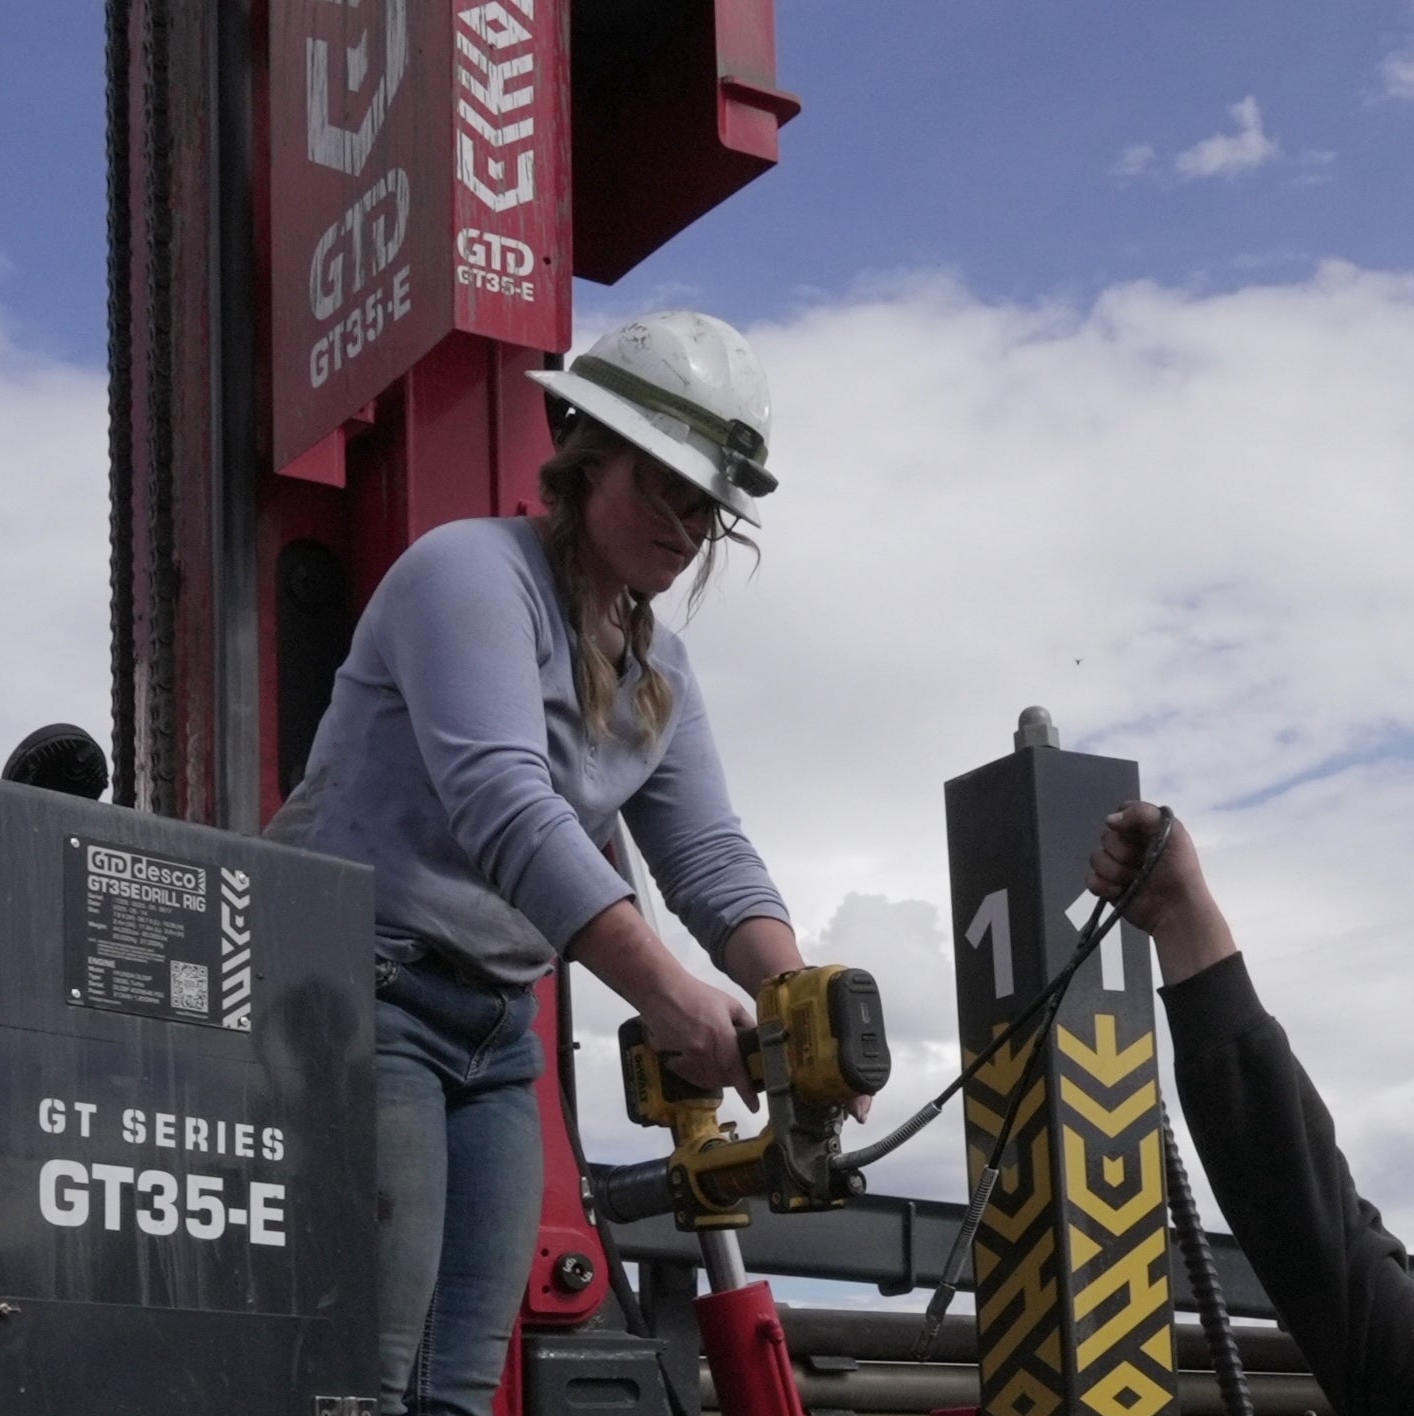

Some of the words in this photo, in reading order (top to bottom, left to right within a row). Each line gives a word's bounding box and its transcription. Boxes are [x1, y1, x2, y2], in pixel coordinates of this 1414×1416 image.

[309, 168, 410, 321] GTD
[456, 227, 535, 278] GTD
[456, 265, 535, 302] GT35-E
[310, 265, 411, 388] GT35-E
[133, 856, 196, 889] desco
[142, 885, 191, 908] DRILL
[183, 894, 207, 912] RIG
[964, 888, 1015, 999] 1
[39, 1098, 97, 1138] GT
[122, 1108, 285, 1161] SERIES
[39, 1158, 286, 1247] GT35-E
